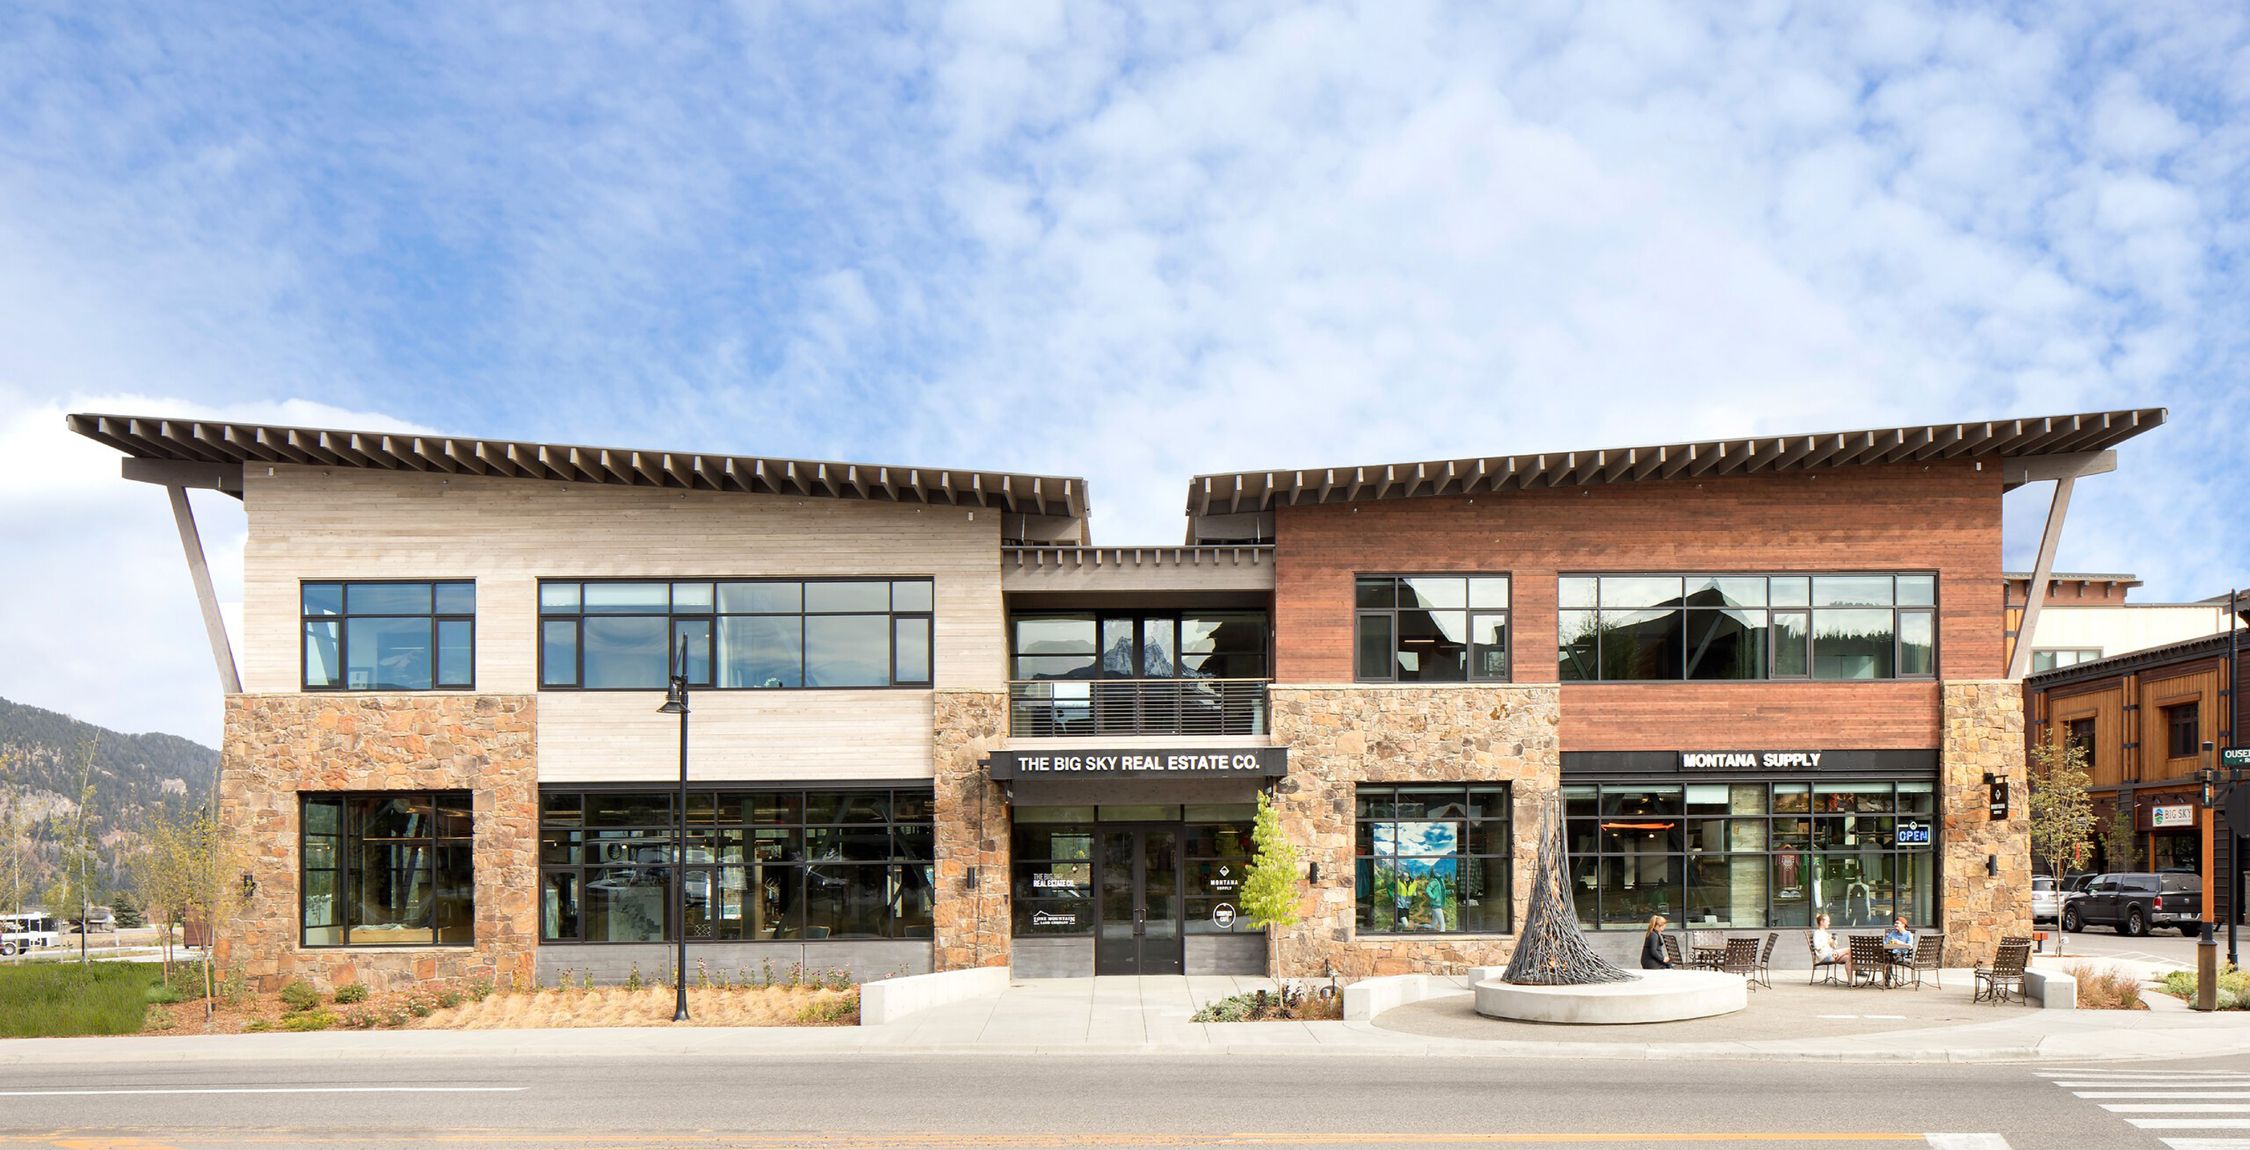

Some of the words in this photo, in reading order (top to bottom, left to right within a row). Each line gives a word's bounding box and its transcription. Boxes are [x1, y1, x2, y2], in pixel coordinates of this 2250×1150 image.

[2225, 749, 2250, 758] OUSE
[1018, 757, 1050, 771] THE
[1053, 757, 1081, 771] BIG
[1085, 756, 1117, 771] SKY
[1121, 756, 1164, 771] REAL
[1168, 756, 1229, 770] ESTATE
[1232, 755, 1260, 769] CO.
[1683, 753, 1757, 767] MONTANA
[1763, 753, 1820, 767] SUPPLY
[2165, 809, 2177, 819] BIG
[2178, 808, 2192, 819] SKY
[1899, 830, 1928, 841] OPEN
